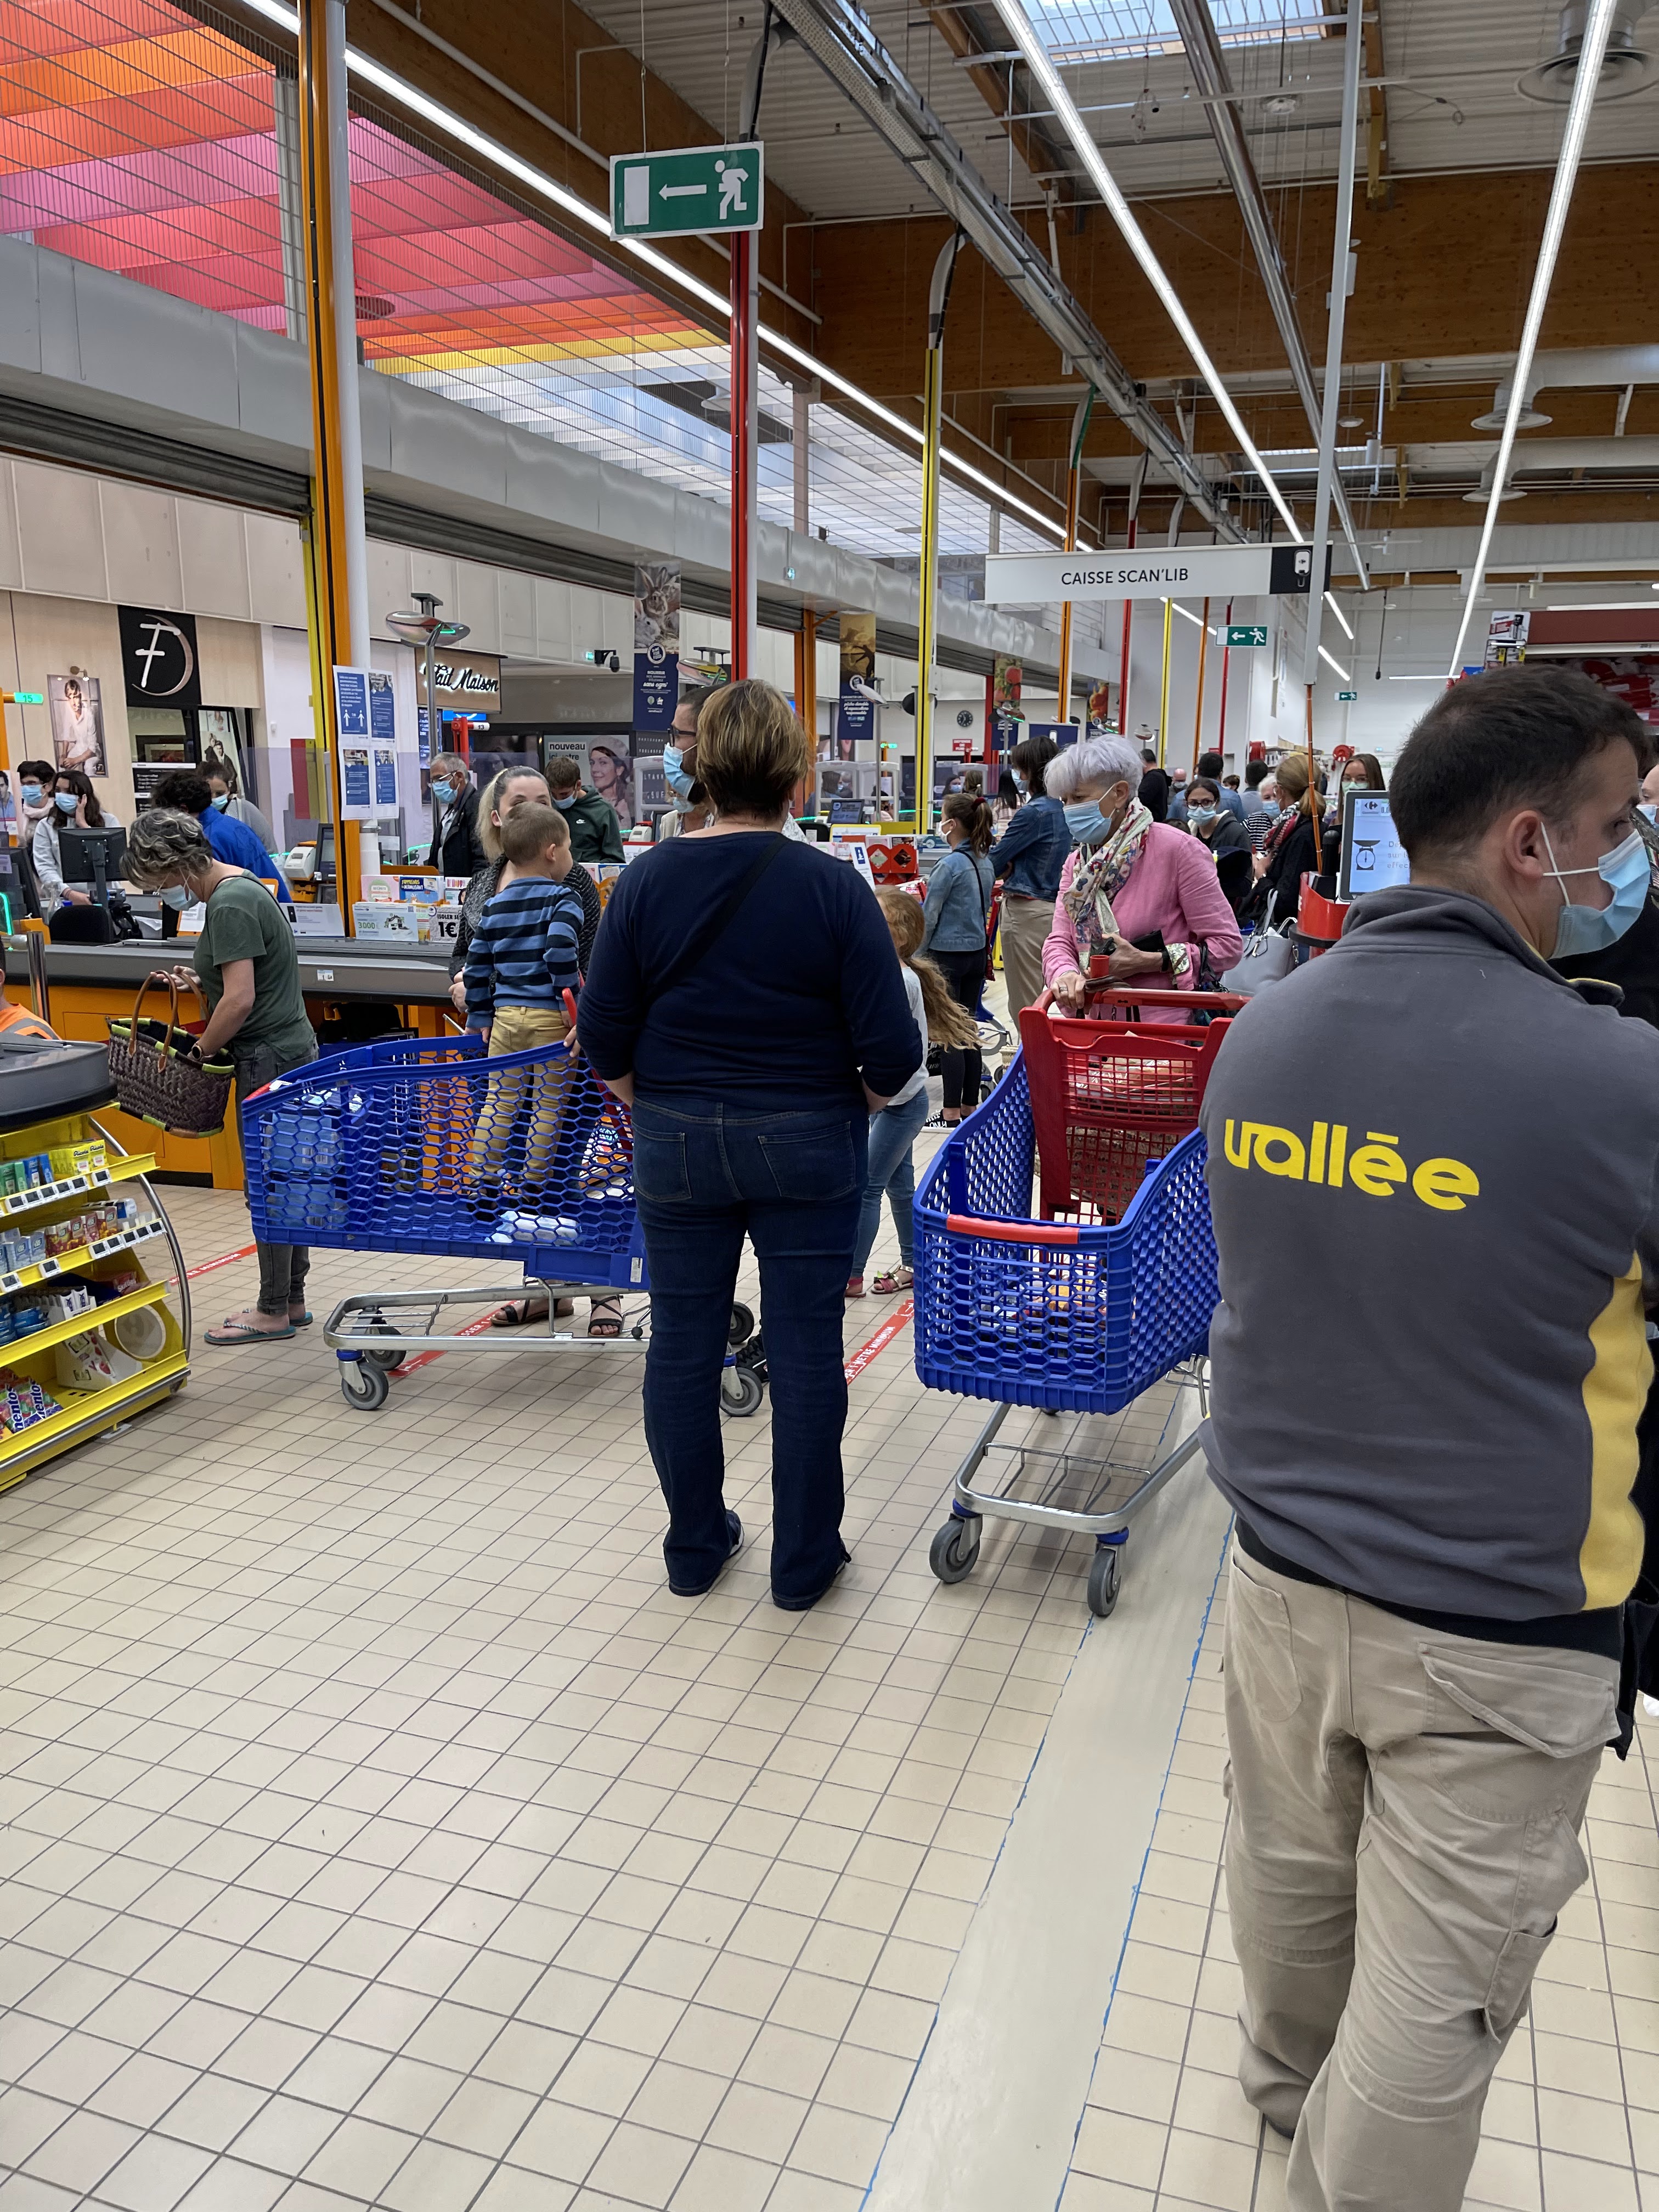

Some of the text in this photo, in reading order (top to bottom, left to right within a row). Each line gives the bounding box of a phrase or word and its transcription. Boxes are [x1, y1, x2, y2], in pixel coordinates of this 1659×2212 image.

[1062, 568, 1188, 585] CAISSE SCAN'LIB
[450, 669, 499, 692] Maison
[23, 695, 33, 703] 15
[438, 922, 458, 938] 1€
[868, 1325, 896, 1348] MINIMUM
